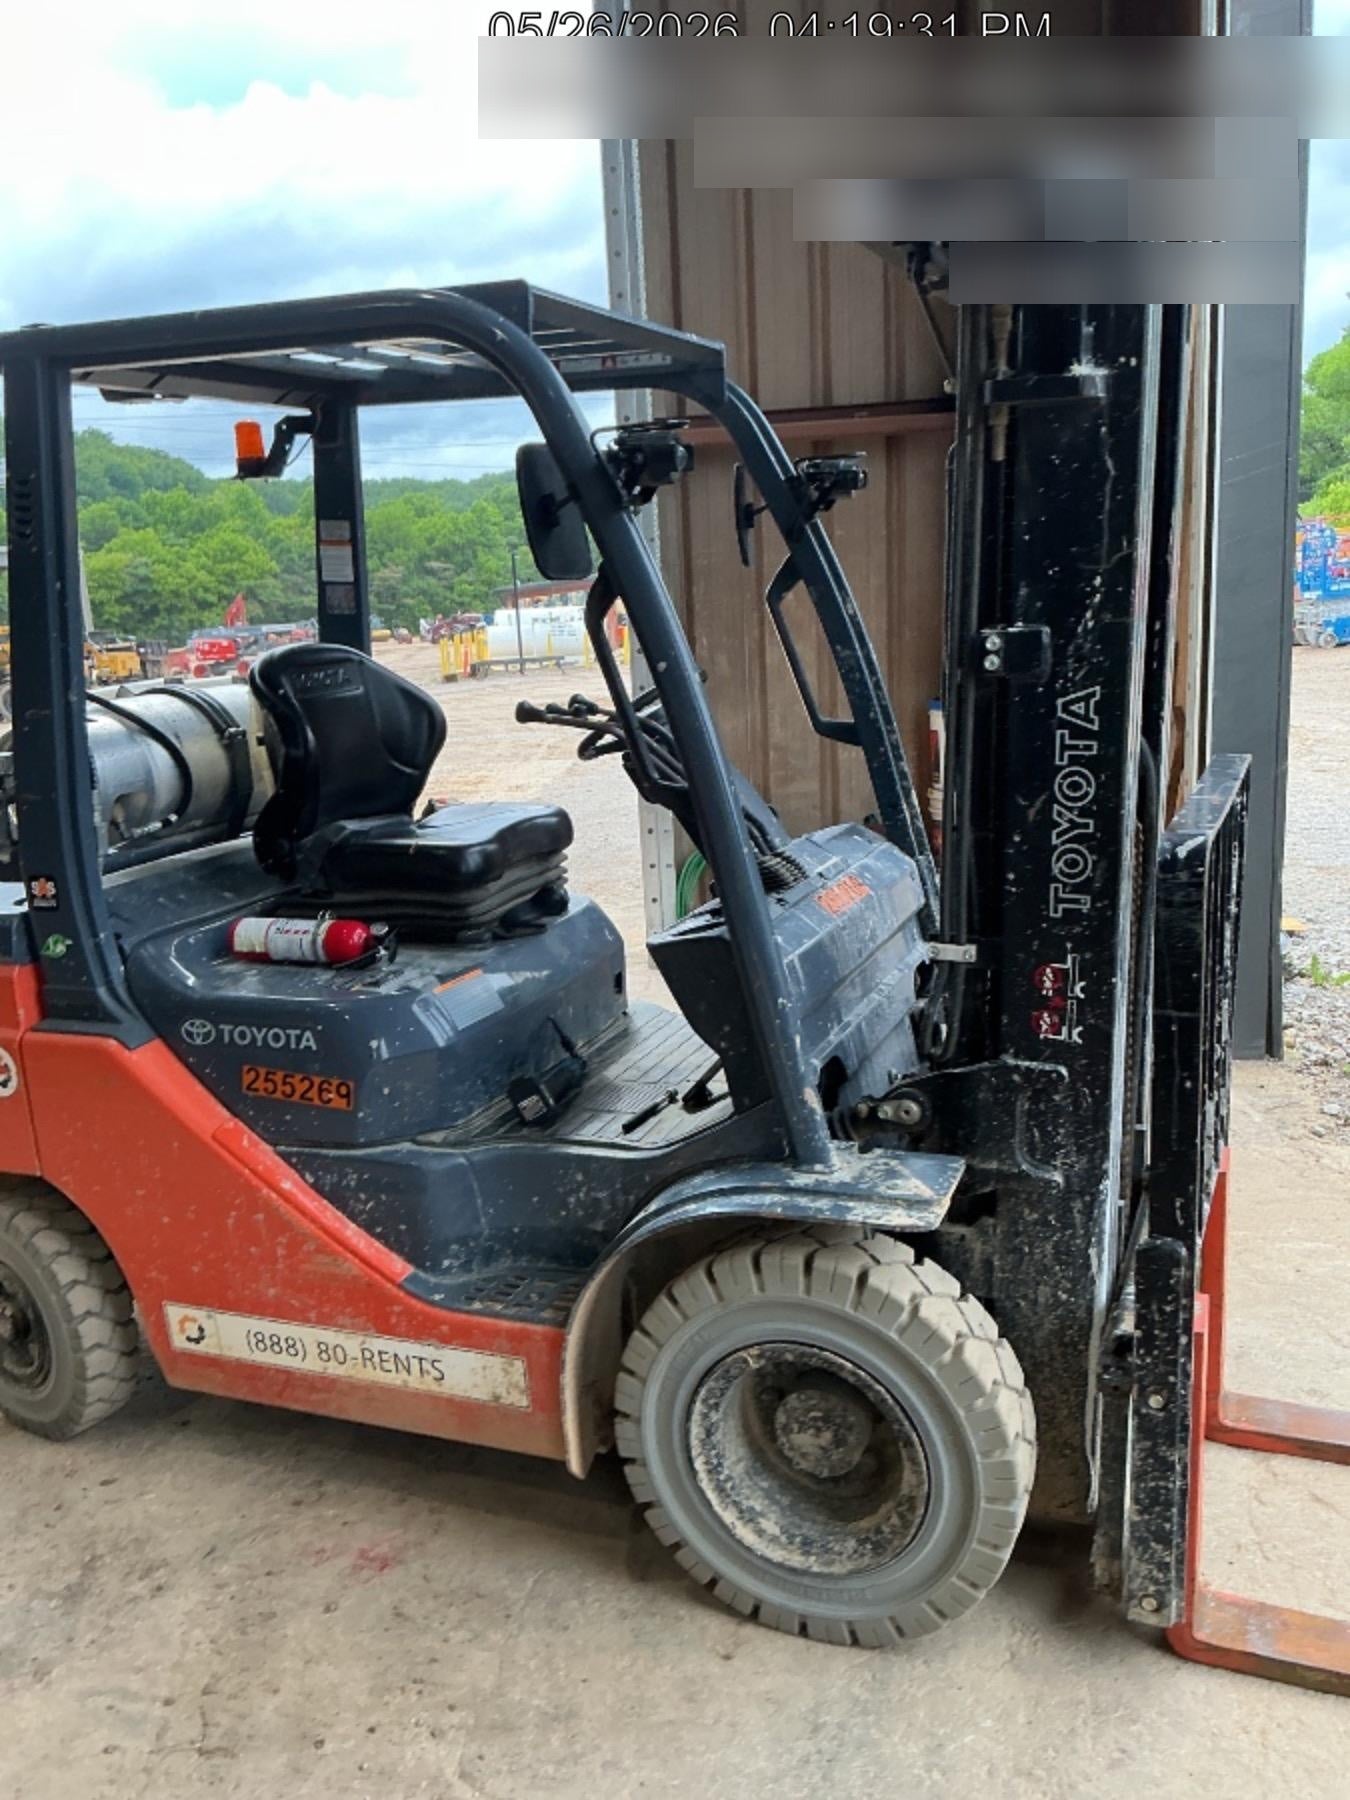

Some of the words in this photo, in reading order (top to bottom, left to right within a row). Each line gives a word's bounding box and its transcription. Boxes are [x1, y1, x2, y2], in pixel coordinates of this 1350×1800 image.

[1049, 685, 1101, 918] TOYOTA
[218, 1023, 318, 1051] TOYOTA
[244, 1067, 352, 1108] 255269
[245, 1329, 307, 1362] (888)
[317, 1340, 446, 1382] 80-RENTS
